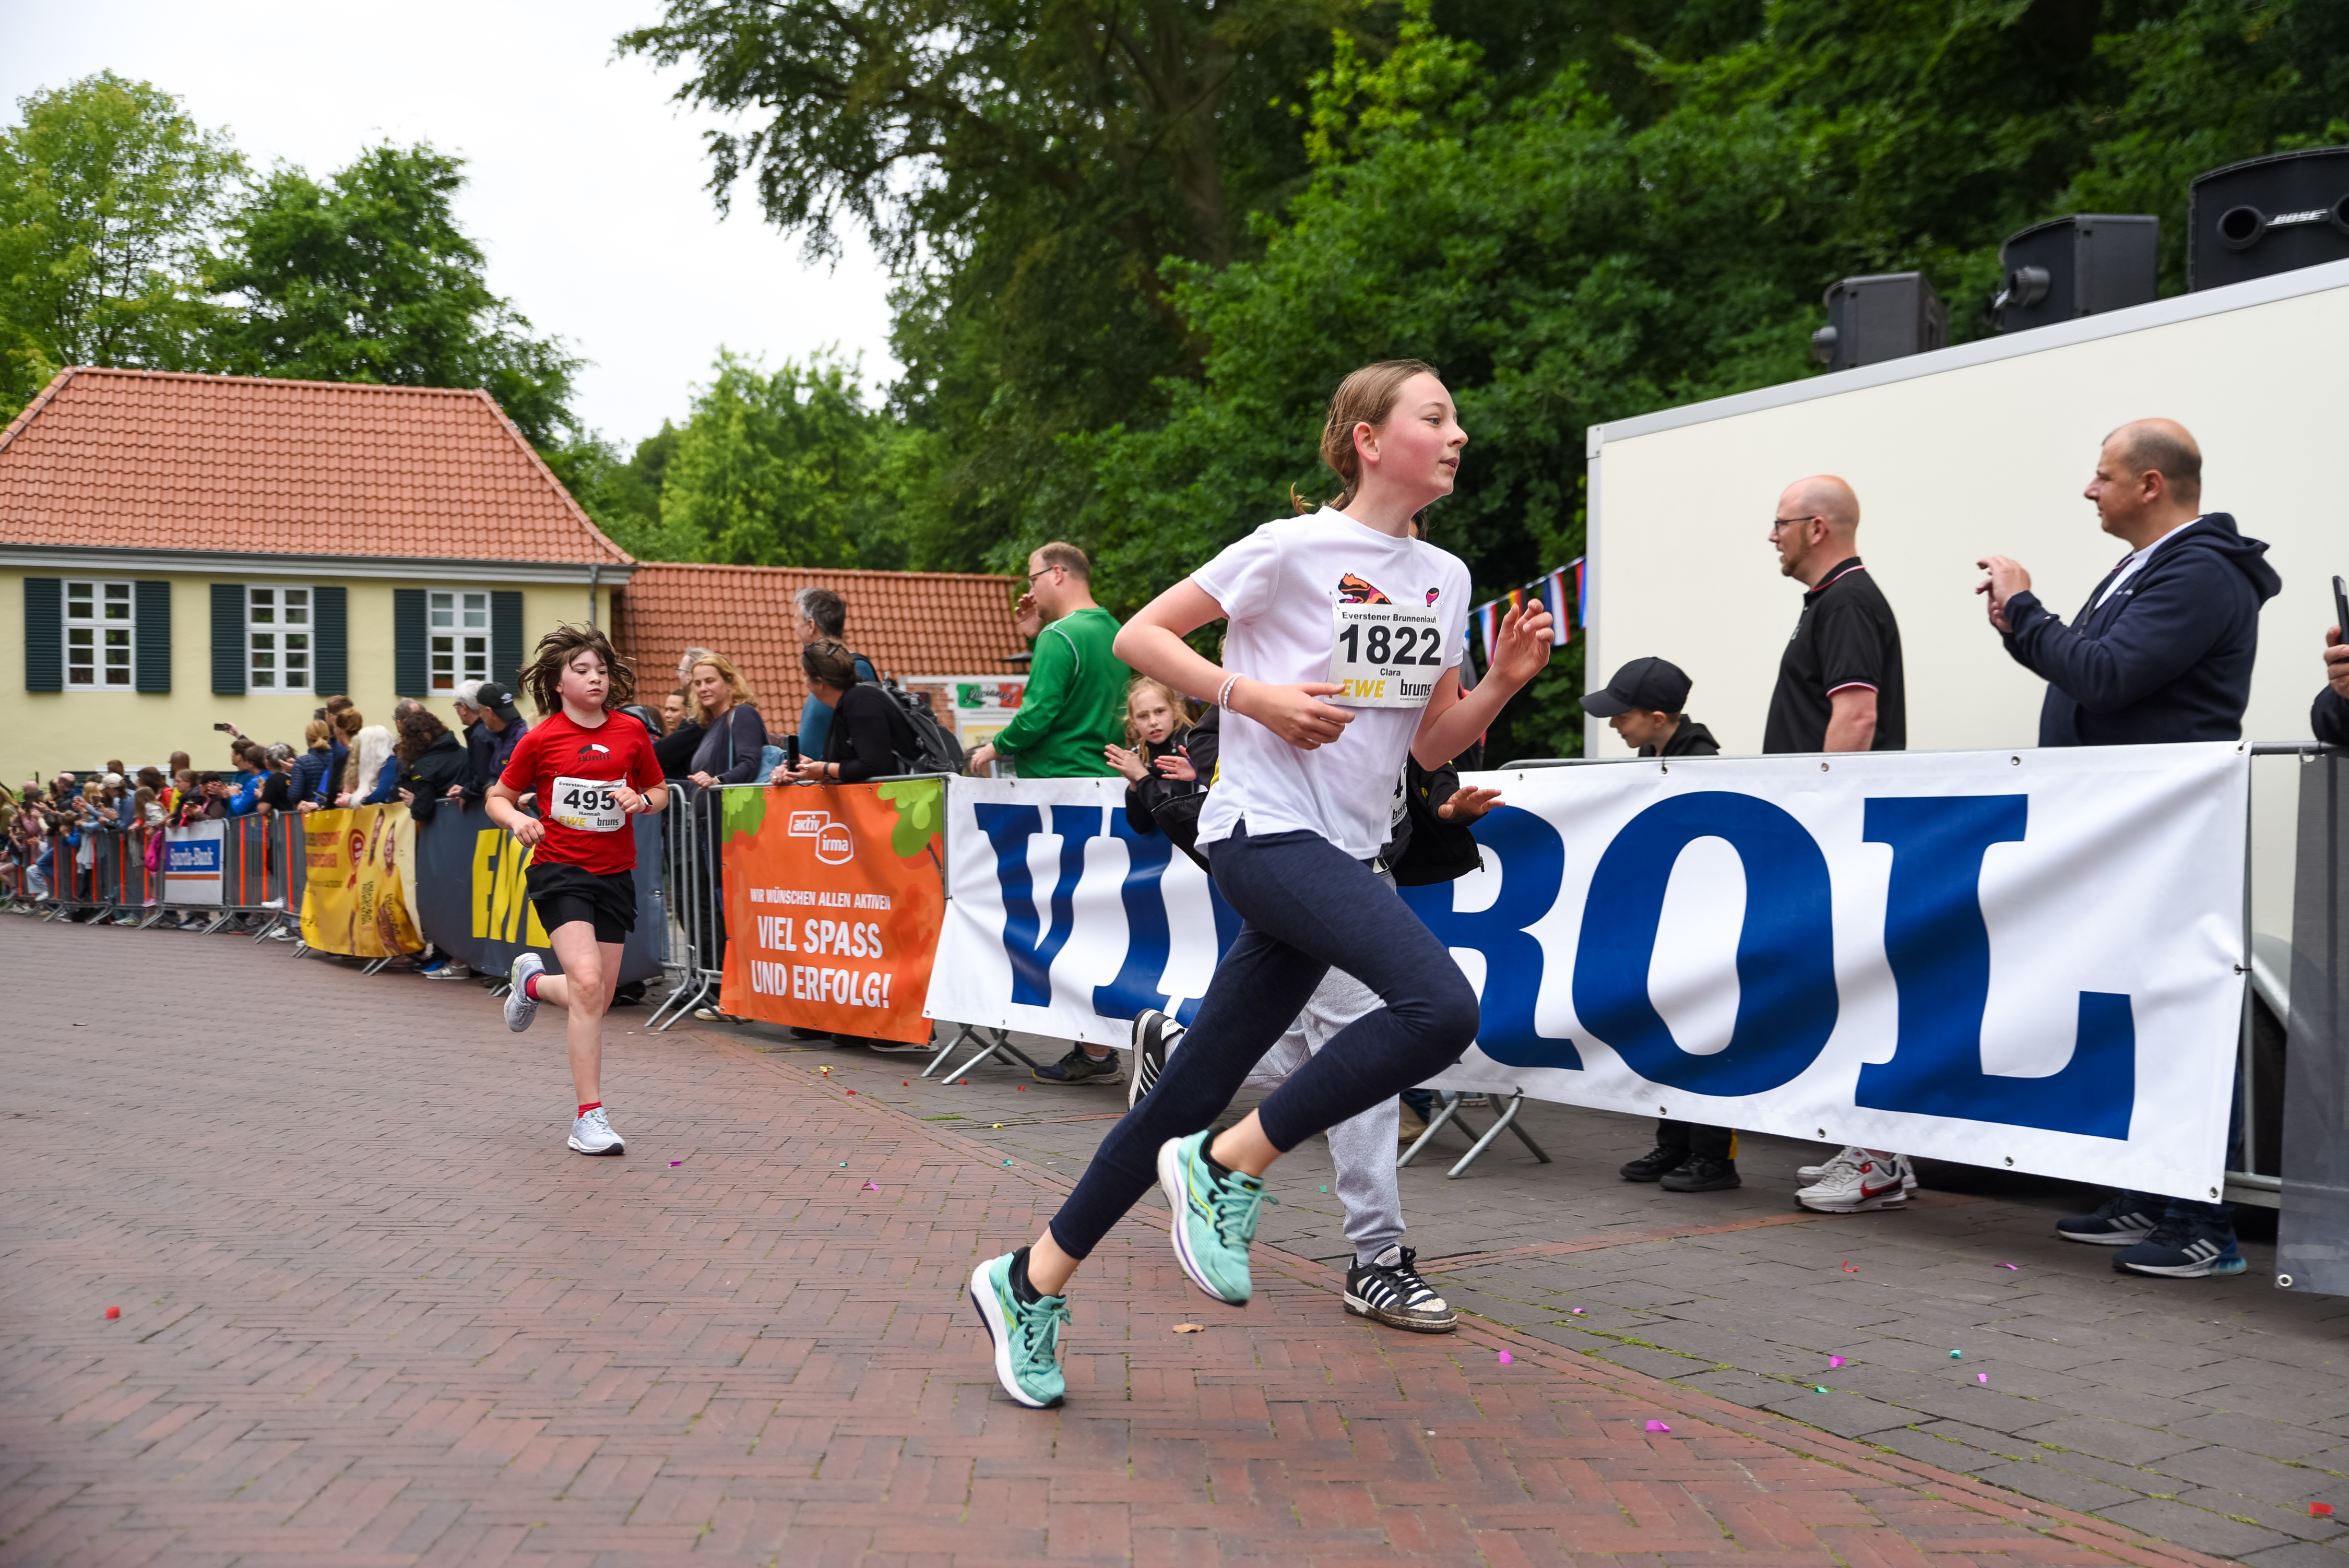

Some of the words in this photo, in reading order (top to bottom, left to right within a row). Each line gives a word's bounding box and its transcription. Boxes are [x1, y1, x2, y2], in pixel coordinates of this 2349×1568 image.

[2265, 209, 2328, 226] BOSE
[1342, 612, 1390, 621] Everstener
[1339, 624, 1441, 666] 1822
[1380, 668, 1401, 676] Clara
[1339, 679, 1385, 698] EWE
[1400, 679, 1432, 696] bruns
[578, 754, 611, 762] skinfit
[563, 789, 615, 810] 495
[559, 816, 586, 826] EWE
[597, 817, 620, 826] bruns
[793, 815, 821, 831] aktiv
[822, 834, 849, 851] irma
[750, 888, 765, 902] WIR
[766, 886, 816, 906] WÜNSCHEN
[818, 892, 851, 907] ALLEN
[854, 894, 891, 910] AKTIVEN
[757, 915, 797, 952] VIEL
[803, 919, 883, 959] SPASS
[974, 791, 2135, 1141] VIROL
[751, 960, 787, 996] UND
[792, 965, 892, 1008] ERFOLG!
[1383, 1254, 1397, 1263] adidas
